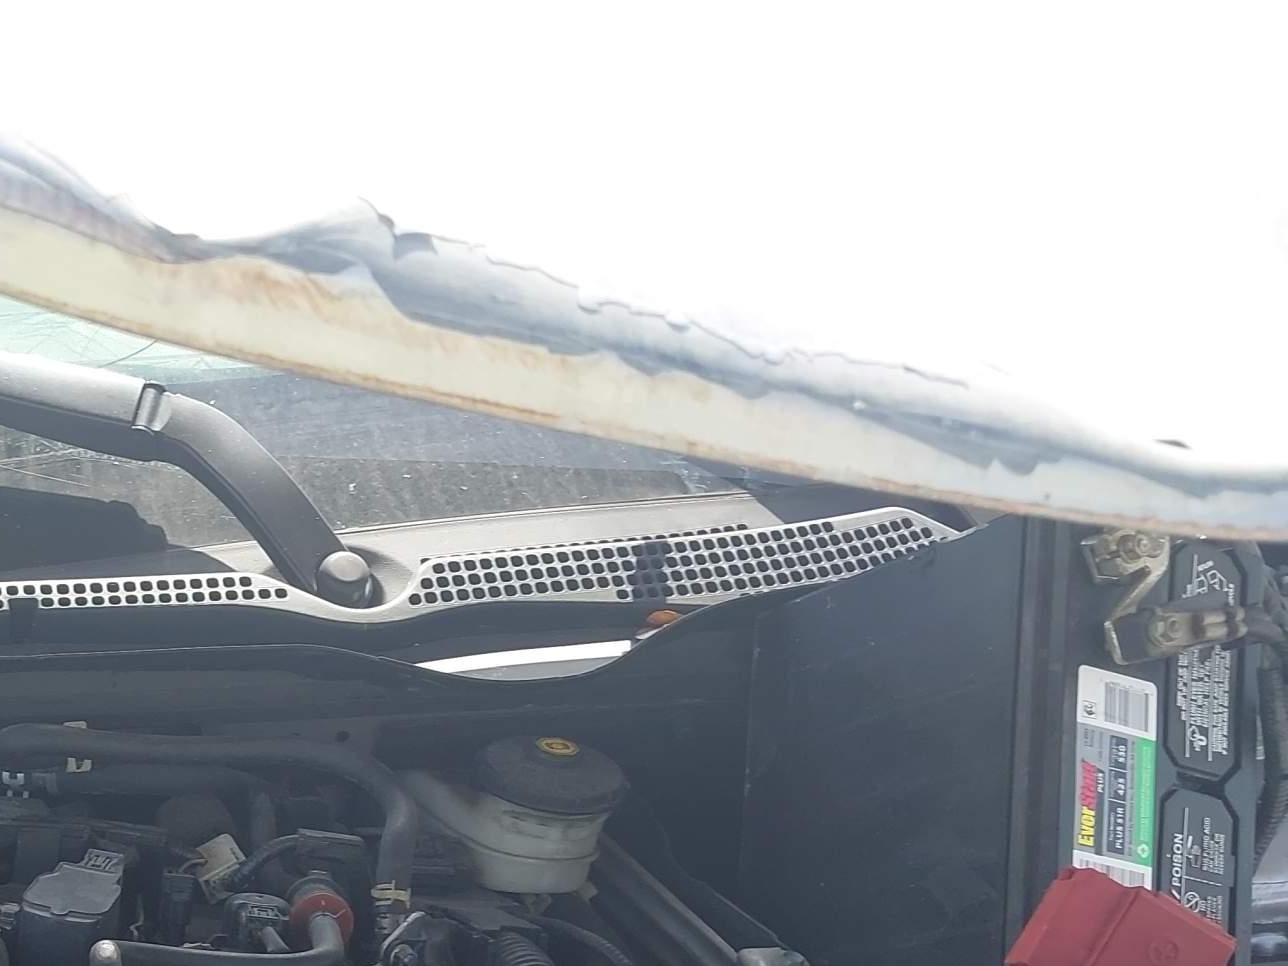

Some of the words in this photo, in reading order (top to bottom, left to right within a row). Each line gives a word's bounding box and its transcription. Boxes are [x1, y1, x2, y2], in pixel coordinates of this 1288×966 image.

[1096, 772, 1105, 793] PLUS
[1114, 826, 1124, 849] PLUS
[1171, 833, 1183, 887] POISON
